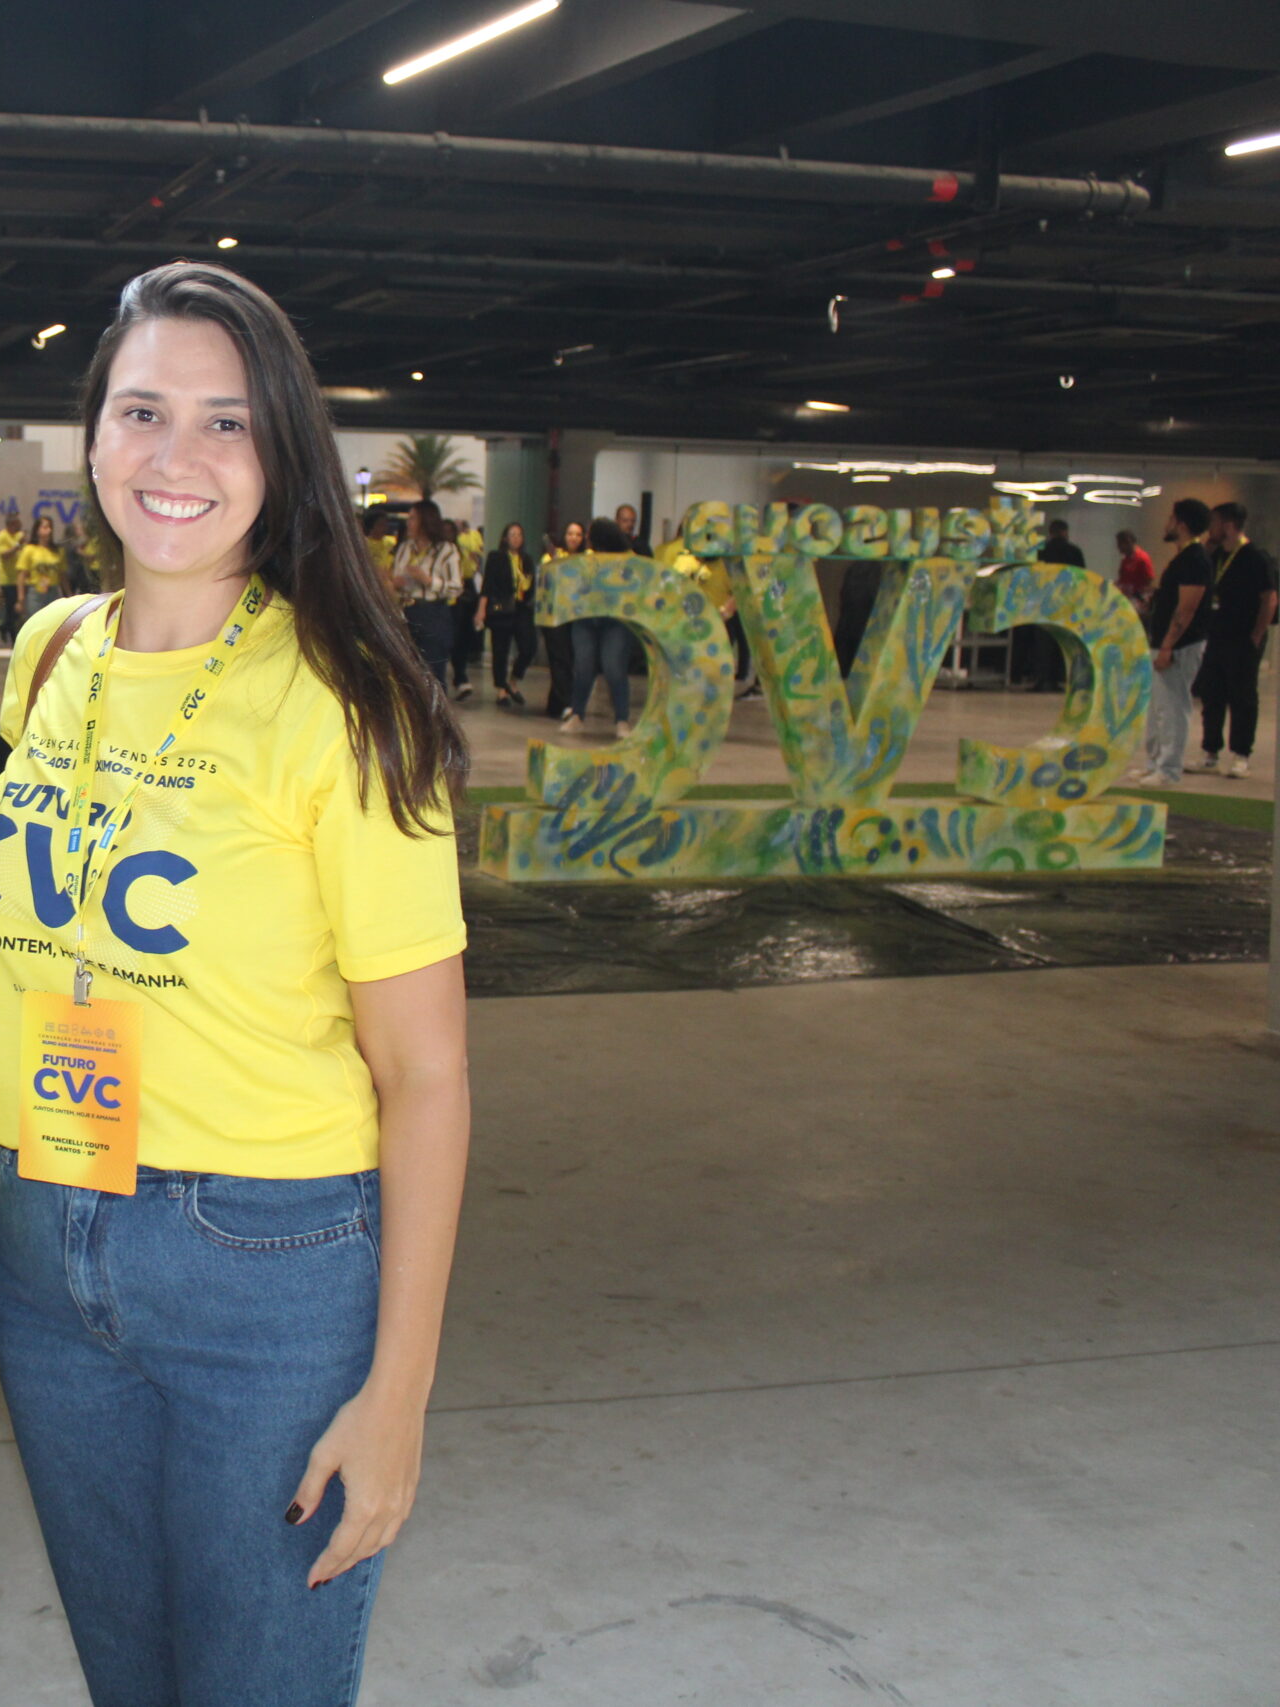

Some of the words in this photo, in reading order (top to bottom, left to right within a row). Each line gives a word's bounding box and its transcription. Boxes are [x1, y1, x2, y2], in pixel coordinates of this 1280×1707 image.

[32, 500, 86, 523] CV
[183, 688, 206, 720] CVC
[46, 757, 71, 770] AOS
[156, 776, 195, 788] ANOS
[110, 745, 168, 766] VENDS
[177, 757, 217, 774] 2025
[42, 1054, 96, 1070] FUTURO
[33, 1068, 122, 1109] CVC
[41, 1135, 83, 1146] FRANCIELLI
[84, 1141, 110, 1151] COUTO
[55, 1145, 81, 1154] SANTOS
